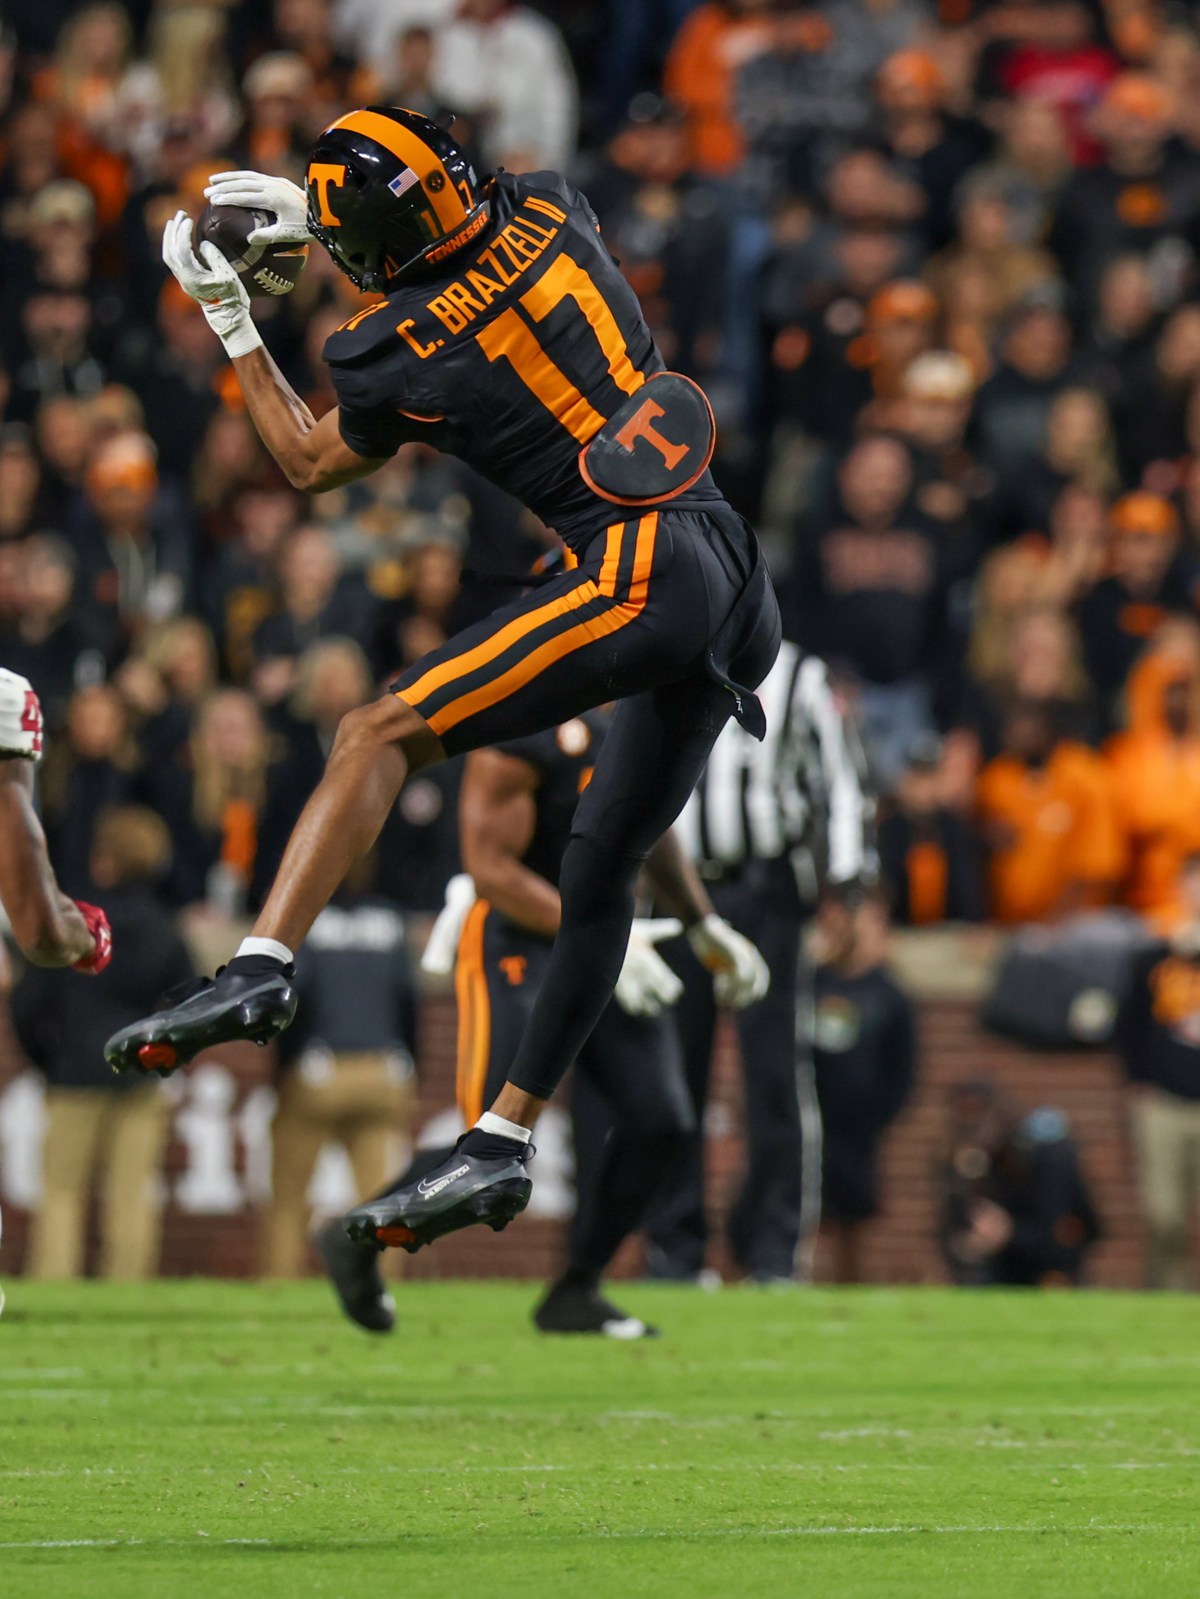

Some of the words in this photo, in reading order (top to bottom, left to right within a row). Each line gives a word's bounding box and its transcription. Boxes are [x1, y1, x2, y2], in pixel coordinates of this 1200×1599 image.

[308, 163, 346, 227] T
[424, 210, 490, 265] TENNESSEE
[395, 318, 446, 360] C.
[426, 214, 559, 336] BRAZZELL
[474, 252, 646, 446] 17
[614, 397, 691, 471] T
